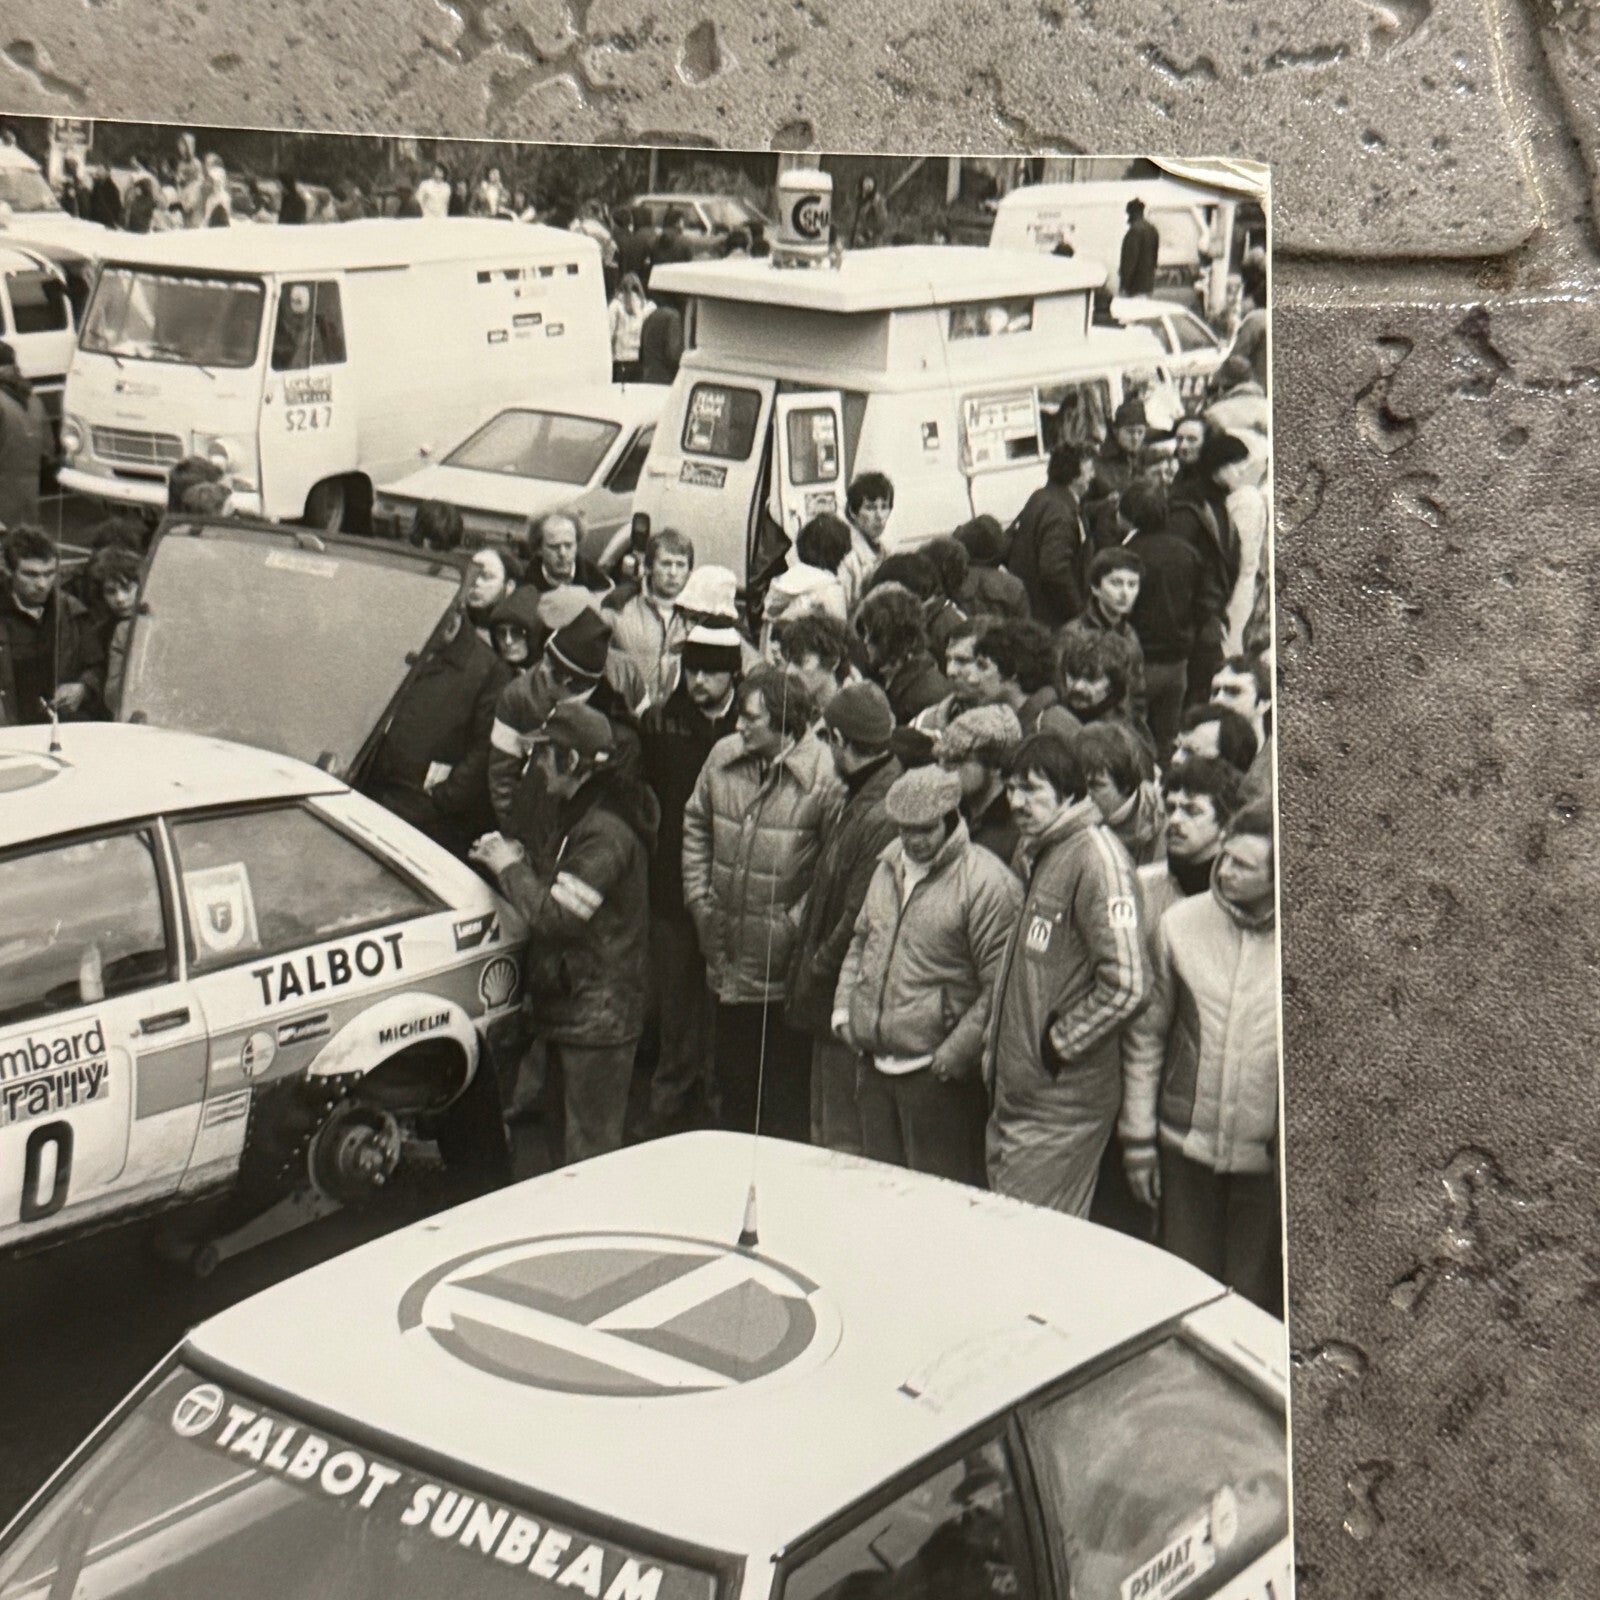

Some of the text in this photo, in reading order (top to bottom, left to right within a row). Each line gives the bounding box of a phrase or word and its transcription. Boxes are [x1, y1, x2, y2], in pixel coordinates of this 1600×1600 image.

[252, 932, 404, 1006] TALBOT
[378, 1011, 450, 1045] MICHELIN
[8, 1061, 104, 1121] rally
[214, 1403, 401, 1509] TALBOT
[400, 1482, 664, 1600] SUNBEAM
